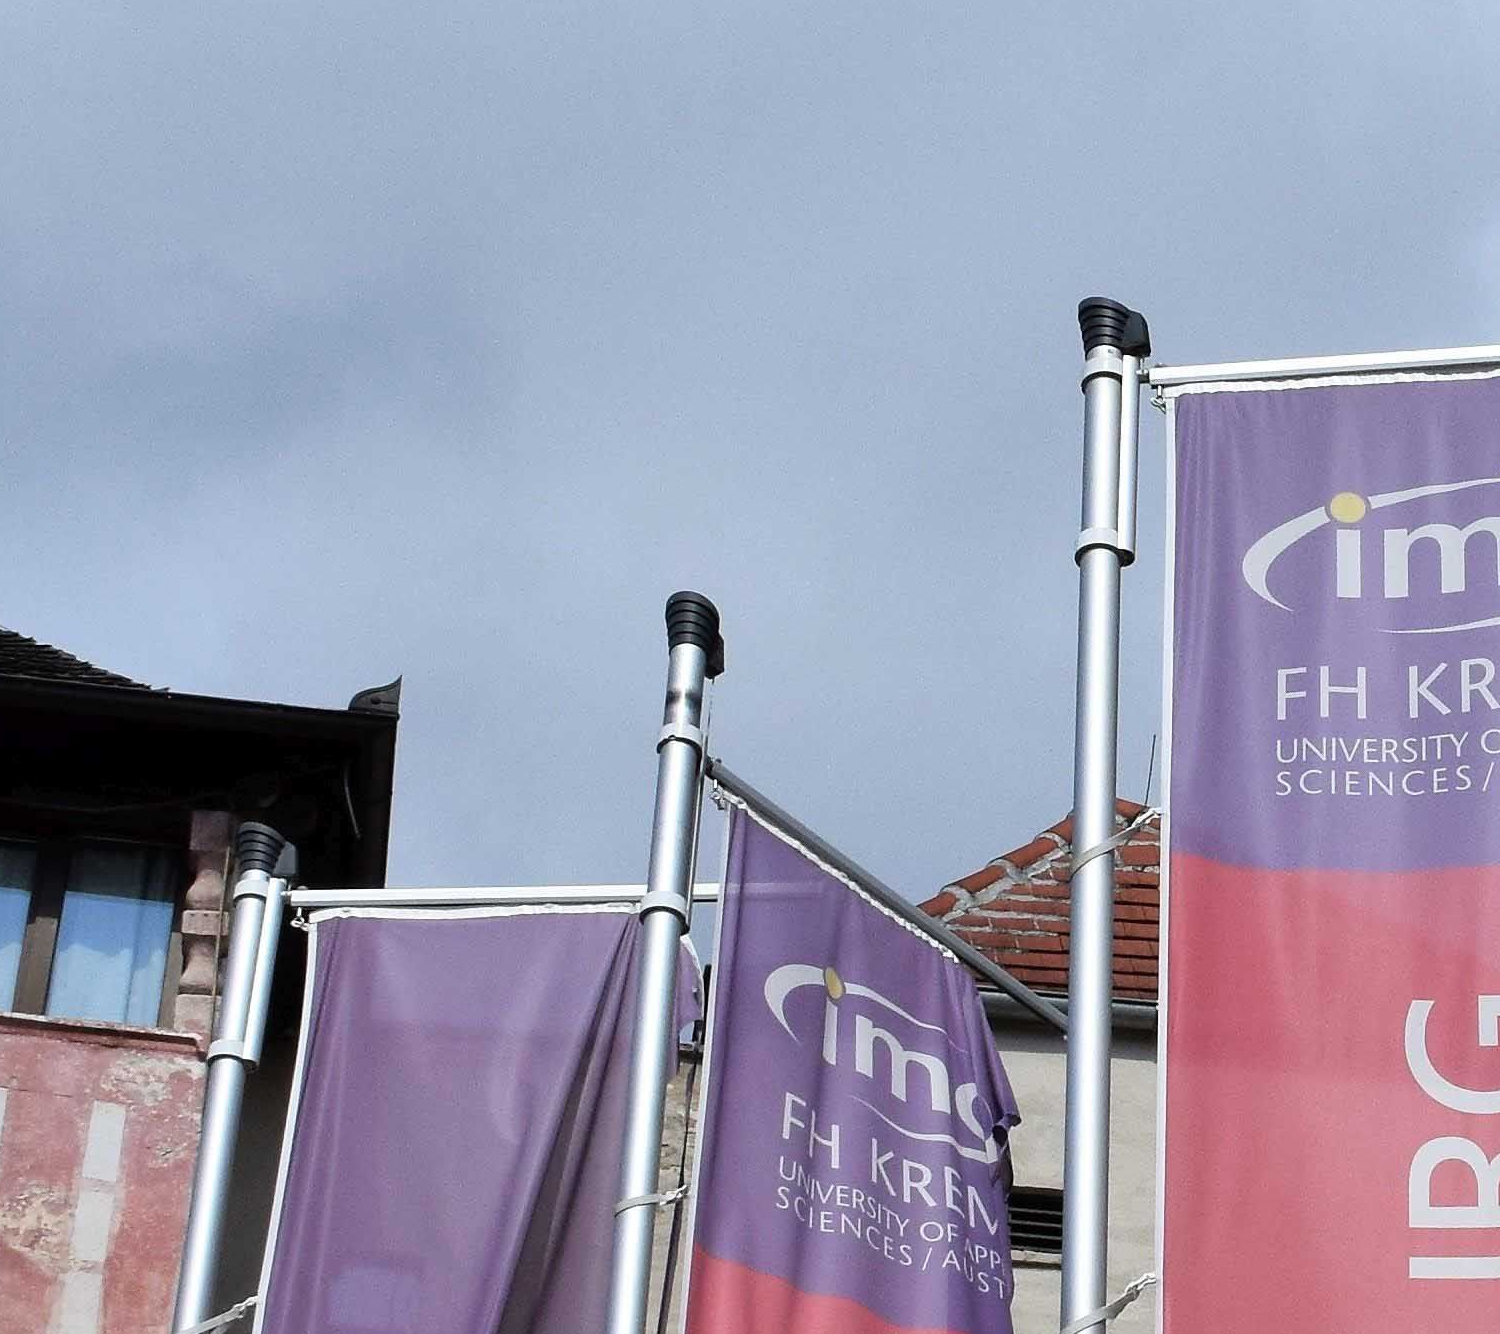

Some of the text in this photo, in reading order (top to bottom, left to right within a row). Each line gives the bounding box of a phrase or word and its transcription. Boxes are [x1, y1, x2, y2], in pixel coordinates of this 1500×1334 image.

[1276, 667, 1367, 720] FH
[1276, 732, 1468, 765] UNIVERSITY
[1276, 763, 1471, 796] SCIENCES
[781, 1092, 1000, 1237] FH KREM
[775, 1186, 913, 1267] SCIENCES
[941, 1248, 1008, 1300] AUST
[779, 1155, 1004, 1275] UNIVERSITY OF APP
